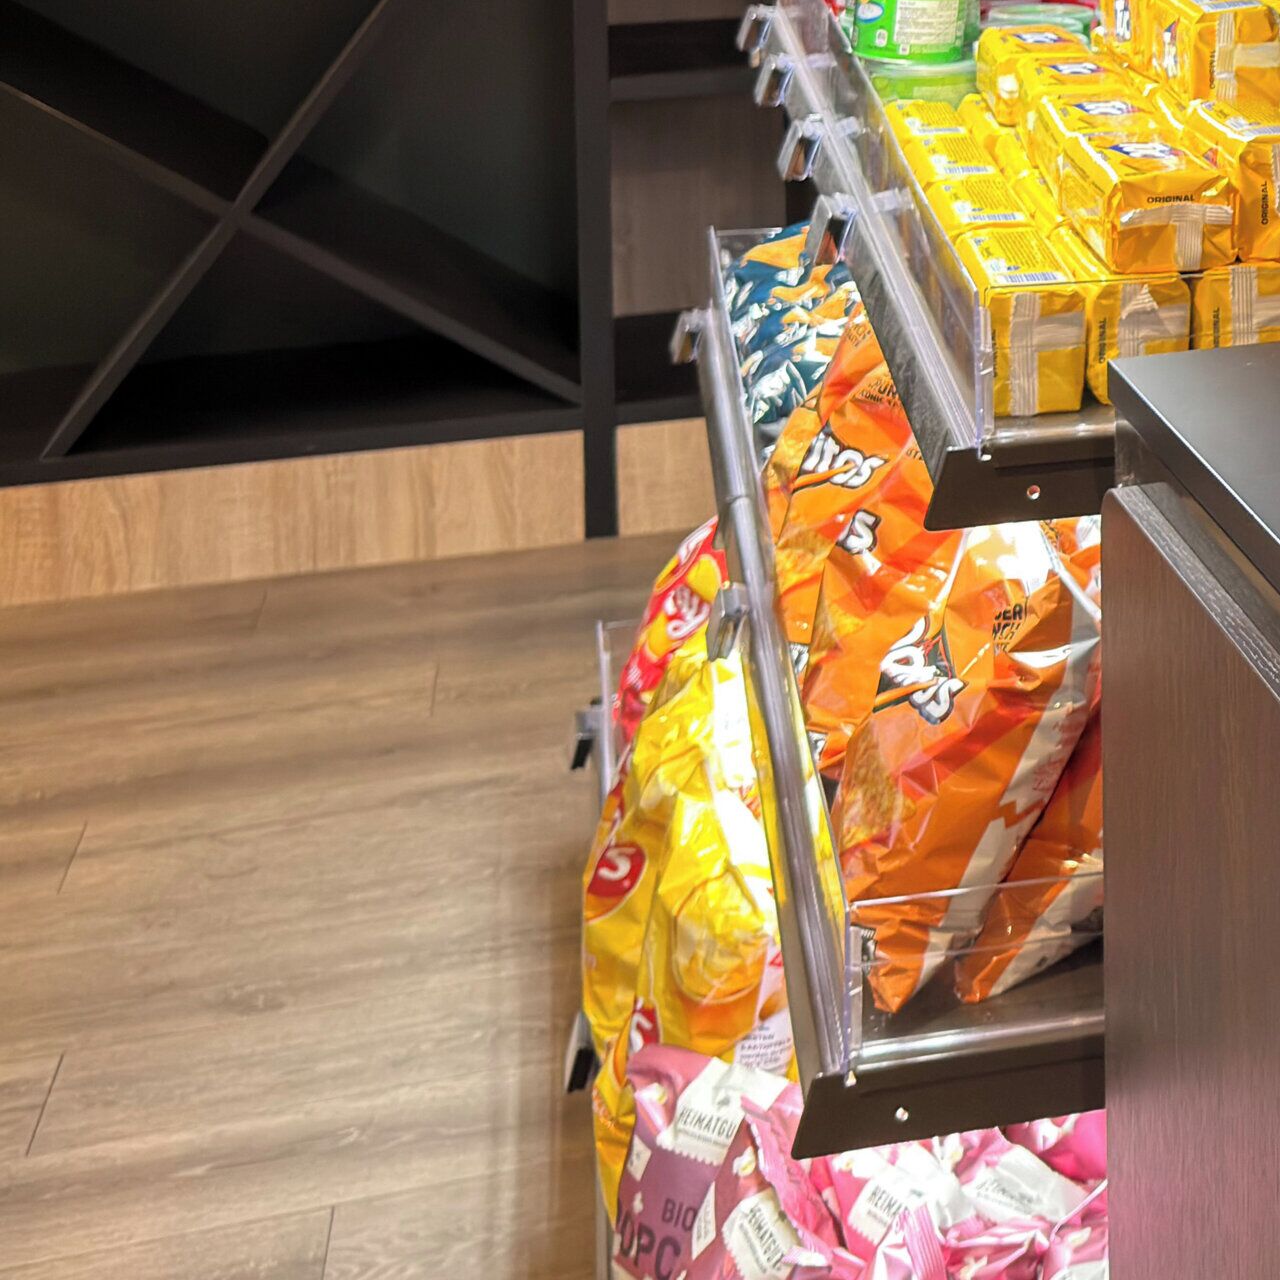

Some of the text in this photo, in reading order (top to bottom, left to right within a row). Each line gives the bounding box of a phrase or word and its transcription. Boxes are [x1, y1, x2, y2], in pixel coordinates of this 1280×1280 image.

[1147, 194, 1195, 204] ORIGINAL
[801, 431, 888, 489] itos
[679, 1107, 737, 1140] HEIMATGU
[662, 1198, 698, 1232] BIO
